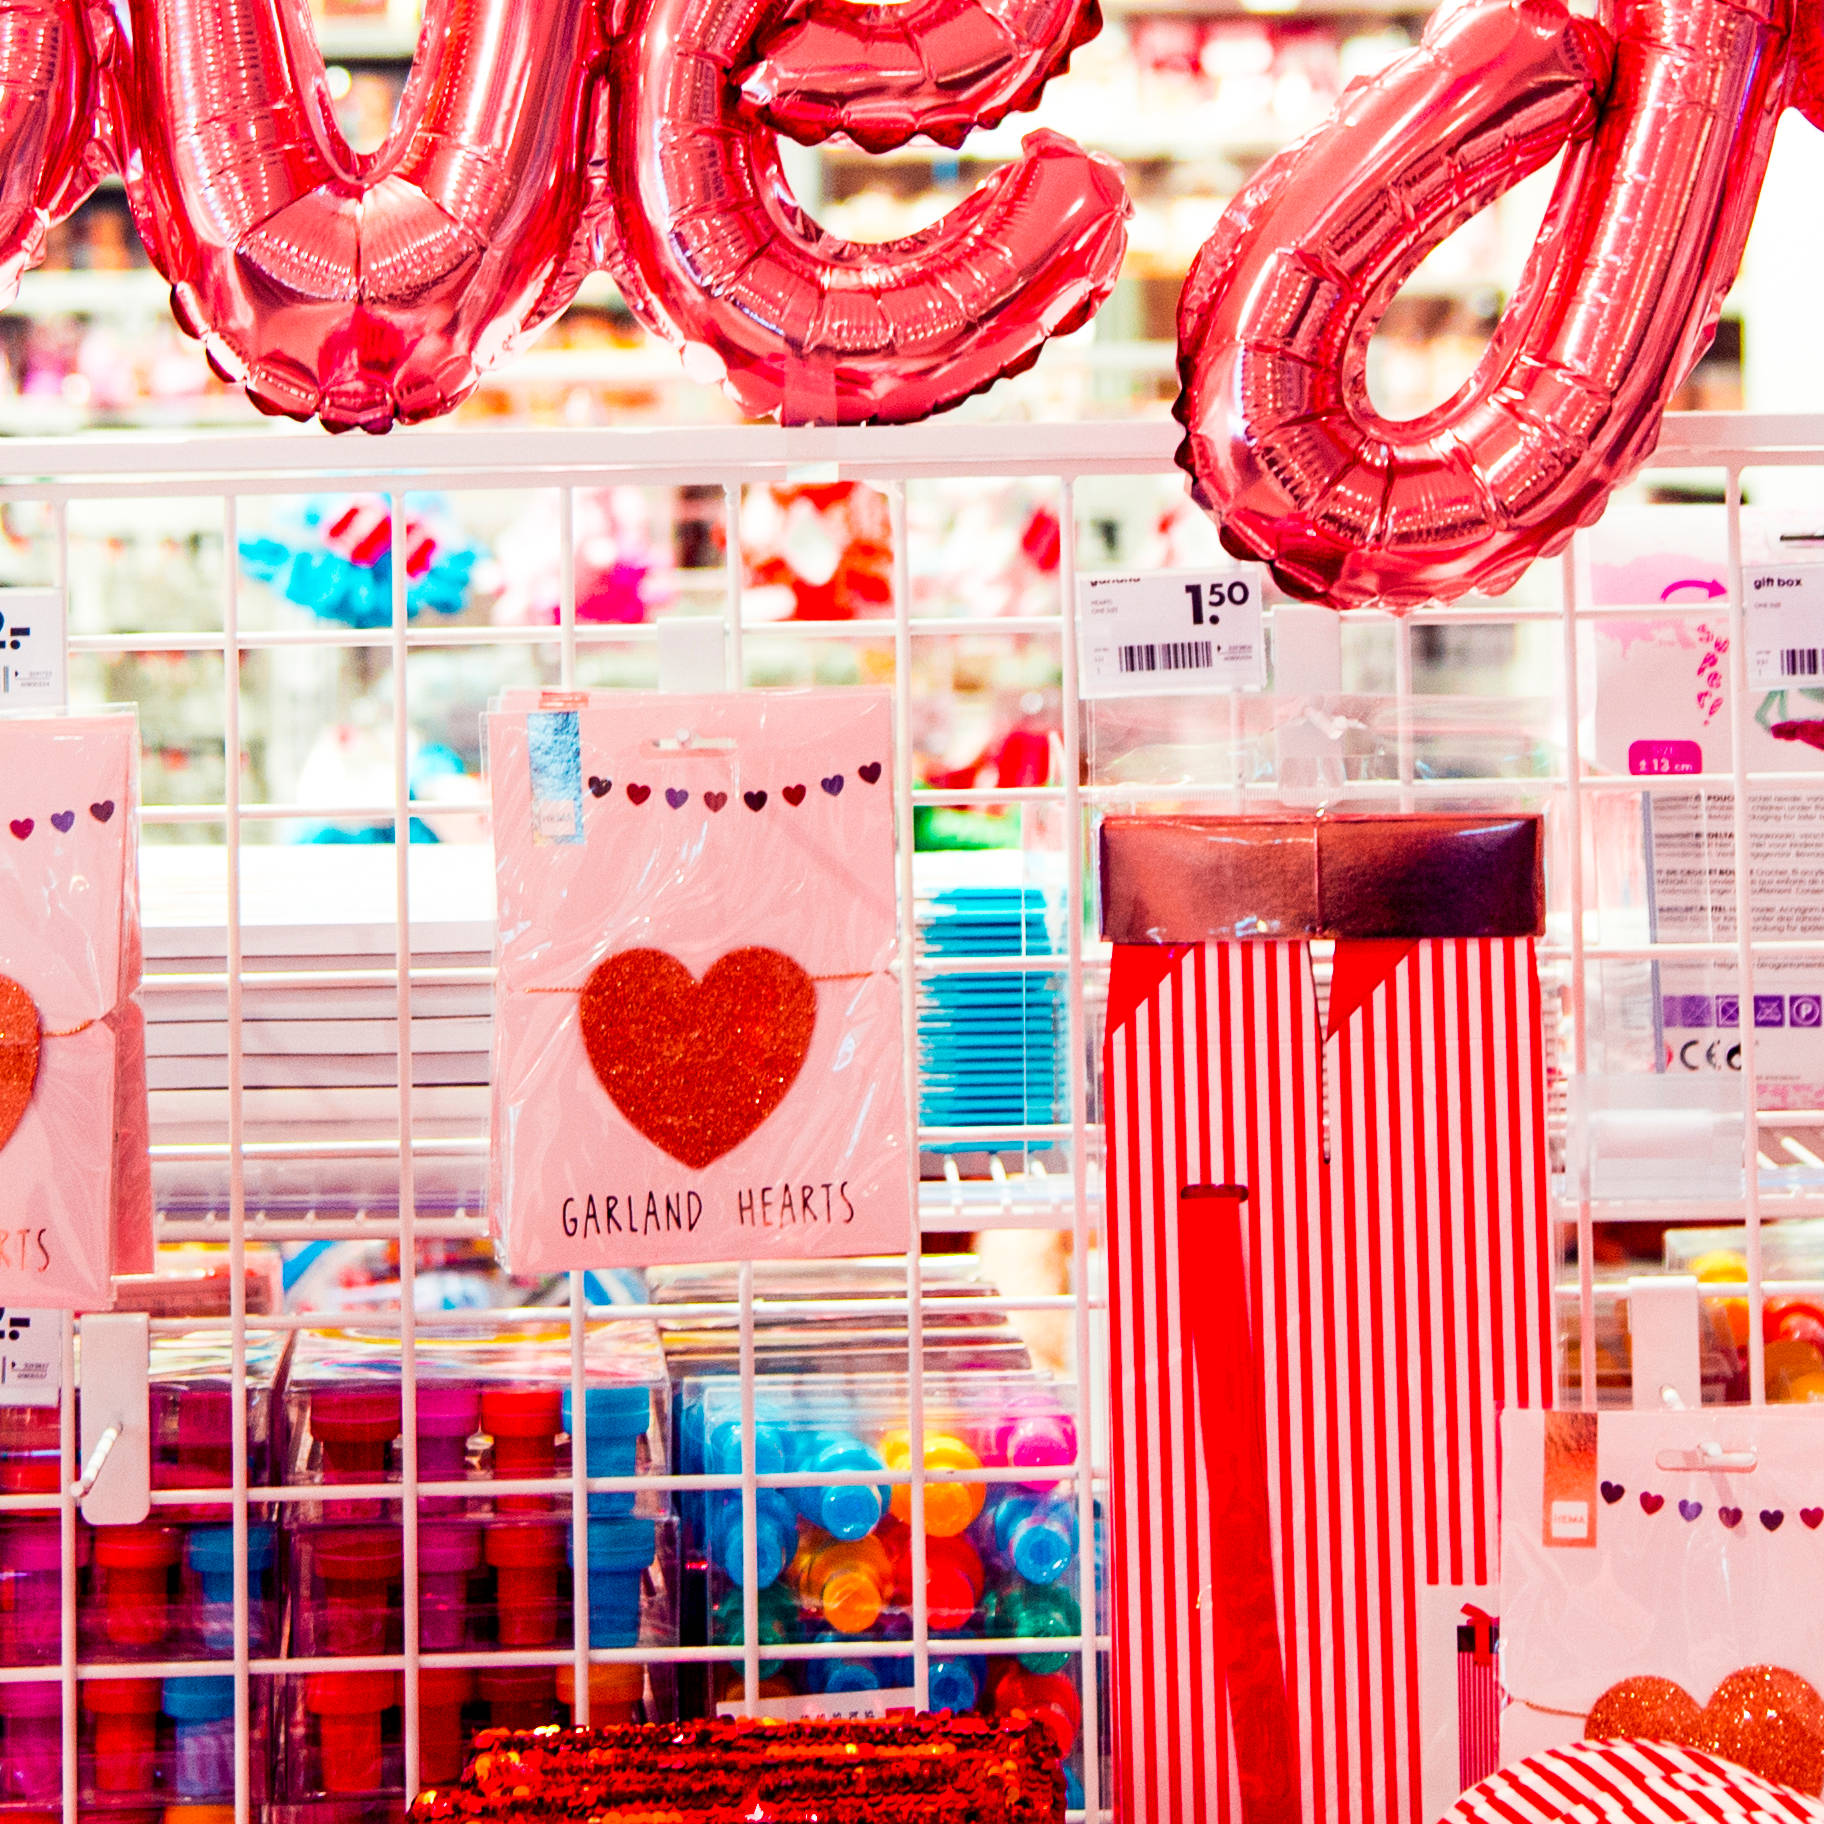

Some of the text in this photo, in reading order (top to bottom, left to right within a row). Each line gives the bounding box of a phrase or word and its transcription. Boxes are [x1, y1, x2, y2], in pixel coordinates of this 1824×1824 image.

[1753, 576, 1803, 590] gift box
[562, 1181, 855, 1239] GARLAND HEARTS
